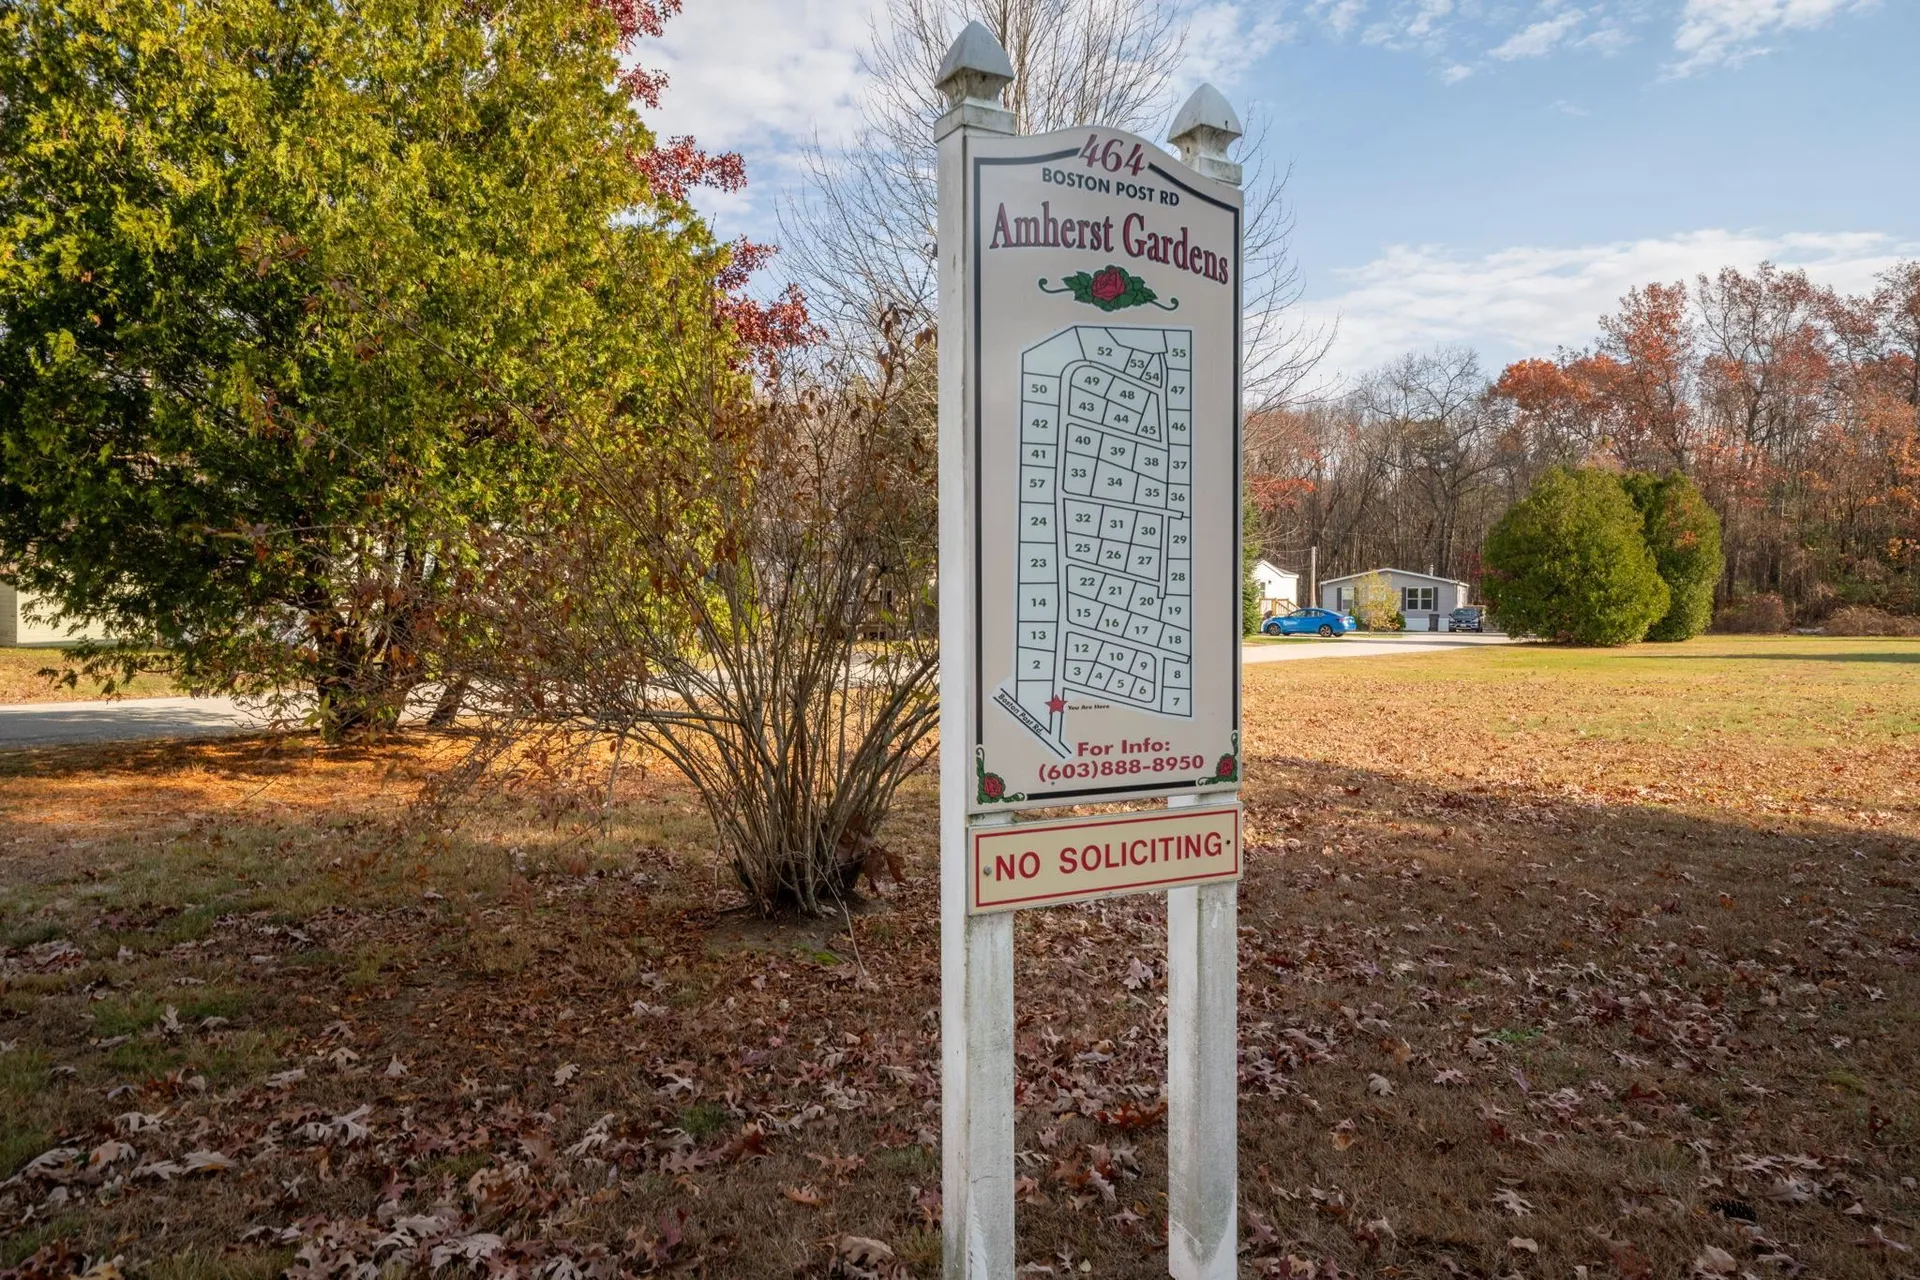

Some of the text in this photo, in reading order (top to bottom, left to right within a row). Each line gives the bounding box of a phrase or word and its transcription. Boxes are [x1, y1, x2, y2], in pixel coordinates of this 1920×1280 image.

[1079, 134, 1145, 177] 464
[1042, 167, 1180, 206] BOSTON POST RD
[989, 201, 1229, 285] Amherst Gardens
[1097, 347, 1113, 356] 52
[1172, 349, 1186, 358] 55
[1130, 359, 1145, 369] 53
[1084, 376, 1100, 386] 49
[1145, 372, 1159, 381] 54
[1031, 384, 1047, 393] 50
[1171, 386, 1185, 395] 47
[1119, 390, 1135, 399] 48
[1079, 402, 1095, 411] 43
[1032, 419, 1048, 428] 42
[1114, 414, 1129, 424] 44
[1141, 426, 1156, 435] 45
[1172, 422, 1186, 431] 46
[1075, 436, 1091, 445] 40
[1031, 449, 1046, 459] 41
[1110, 447, 1126, 456] 39
[1144, 457, 1159, 466] 38
[1173, 461, 1187, 469] 37
[1071, 468, 1086, 477] 33
[1029, 479, 1045, 488] 57
[1107, 477, 1123, 487] 34
[1145, 488, 1160, 497] 35
[1171, 493, 1185, 502] 36
[1031, 517, 1047, 526] 24
[1075, 513, 1091, 523] 32
[1110, 519, 1124, 529] 31
[1141, 527, 1156, 535] 30
[1172, 535, 1187, 544] 29
[1075, 543, 1091, 553] 25
[1106, 551, 1121, 559] 26
[1031, 558, 1047, 568] 23
[1138, 556, 1152, 565] 27
[1080, 577, 1095, 587] 22
[1171, 573, 1185, 582] 28
[1109, 586, 1122, 595] 21
[1031, 598, 1046, 607] 14
[1139, 597, 1154, 606] 20
[1077, 609, 1091, 618] 15
[1168, 606, 1182, 615] 19
[1105, 619, 1119, 628] 16
[1135, 626, 1149, 635] 17
[1031, 631, 1046, 640] 13
[1168, 636, 1182, 644] 18
[1075, 644, 1089, 653] 12
[1110, 652, 1124, 661] 10
[1033, 660, 1041, 669] 2
[1140, 661, 1148, 671] 9
[1074, 667, 1081, 676] 3
[1174, 670, 1181, 679] 8
[1117, 679, 1124, 689] 5
[1139, 686, 1146, 695] 6
[1173, 697, 1180, 706] 7
[998, 693, 1042, 735] Boston Post Rd.
[1077, 737, 1170, 757] For Info:
[1038, 755, 1204, 782] (603)888-8950
[995, 832, 1222, 881] NO SOLICITING
